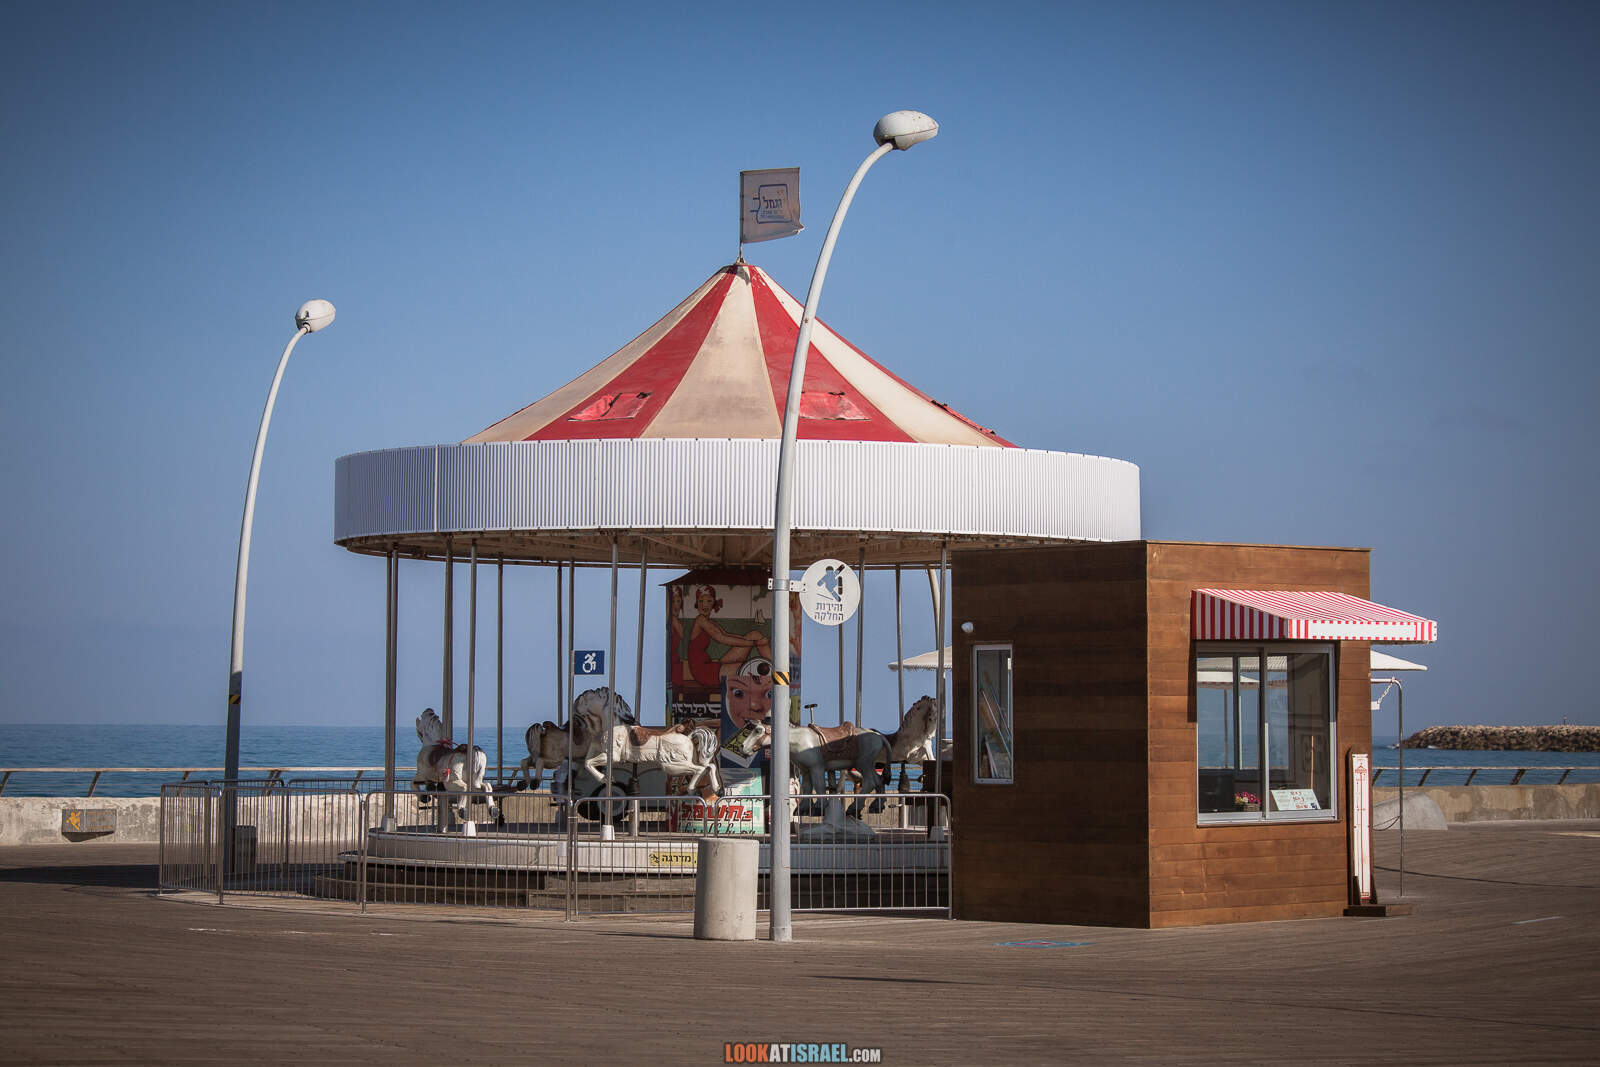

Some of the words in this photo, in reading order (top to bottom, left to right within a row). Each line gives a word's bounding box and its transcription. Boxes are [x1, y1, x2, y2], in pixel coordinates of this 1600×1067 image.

[816, 602, 843, 612] זהירות
[814, 611, 844, 621] החלקה
[662, 855, 691, 863] מדרגה
